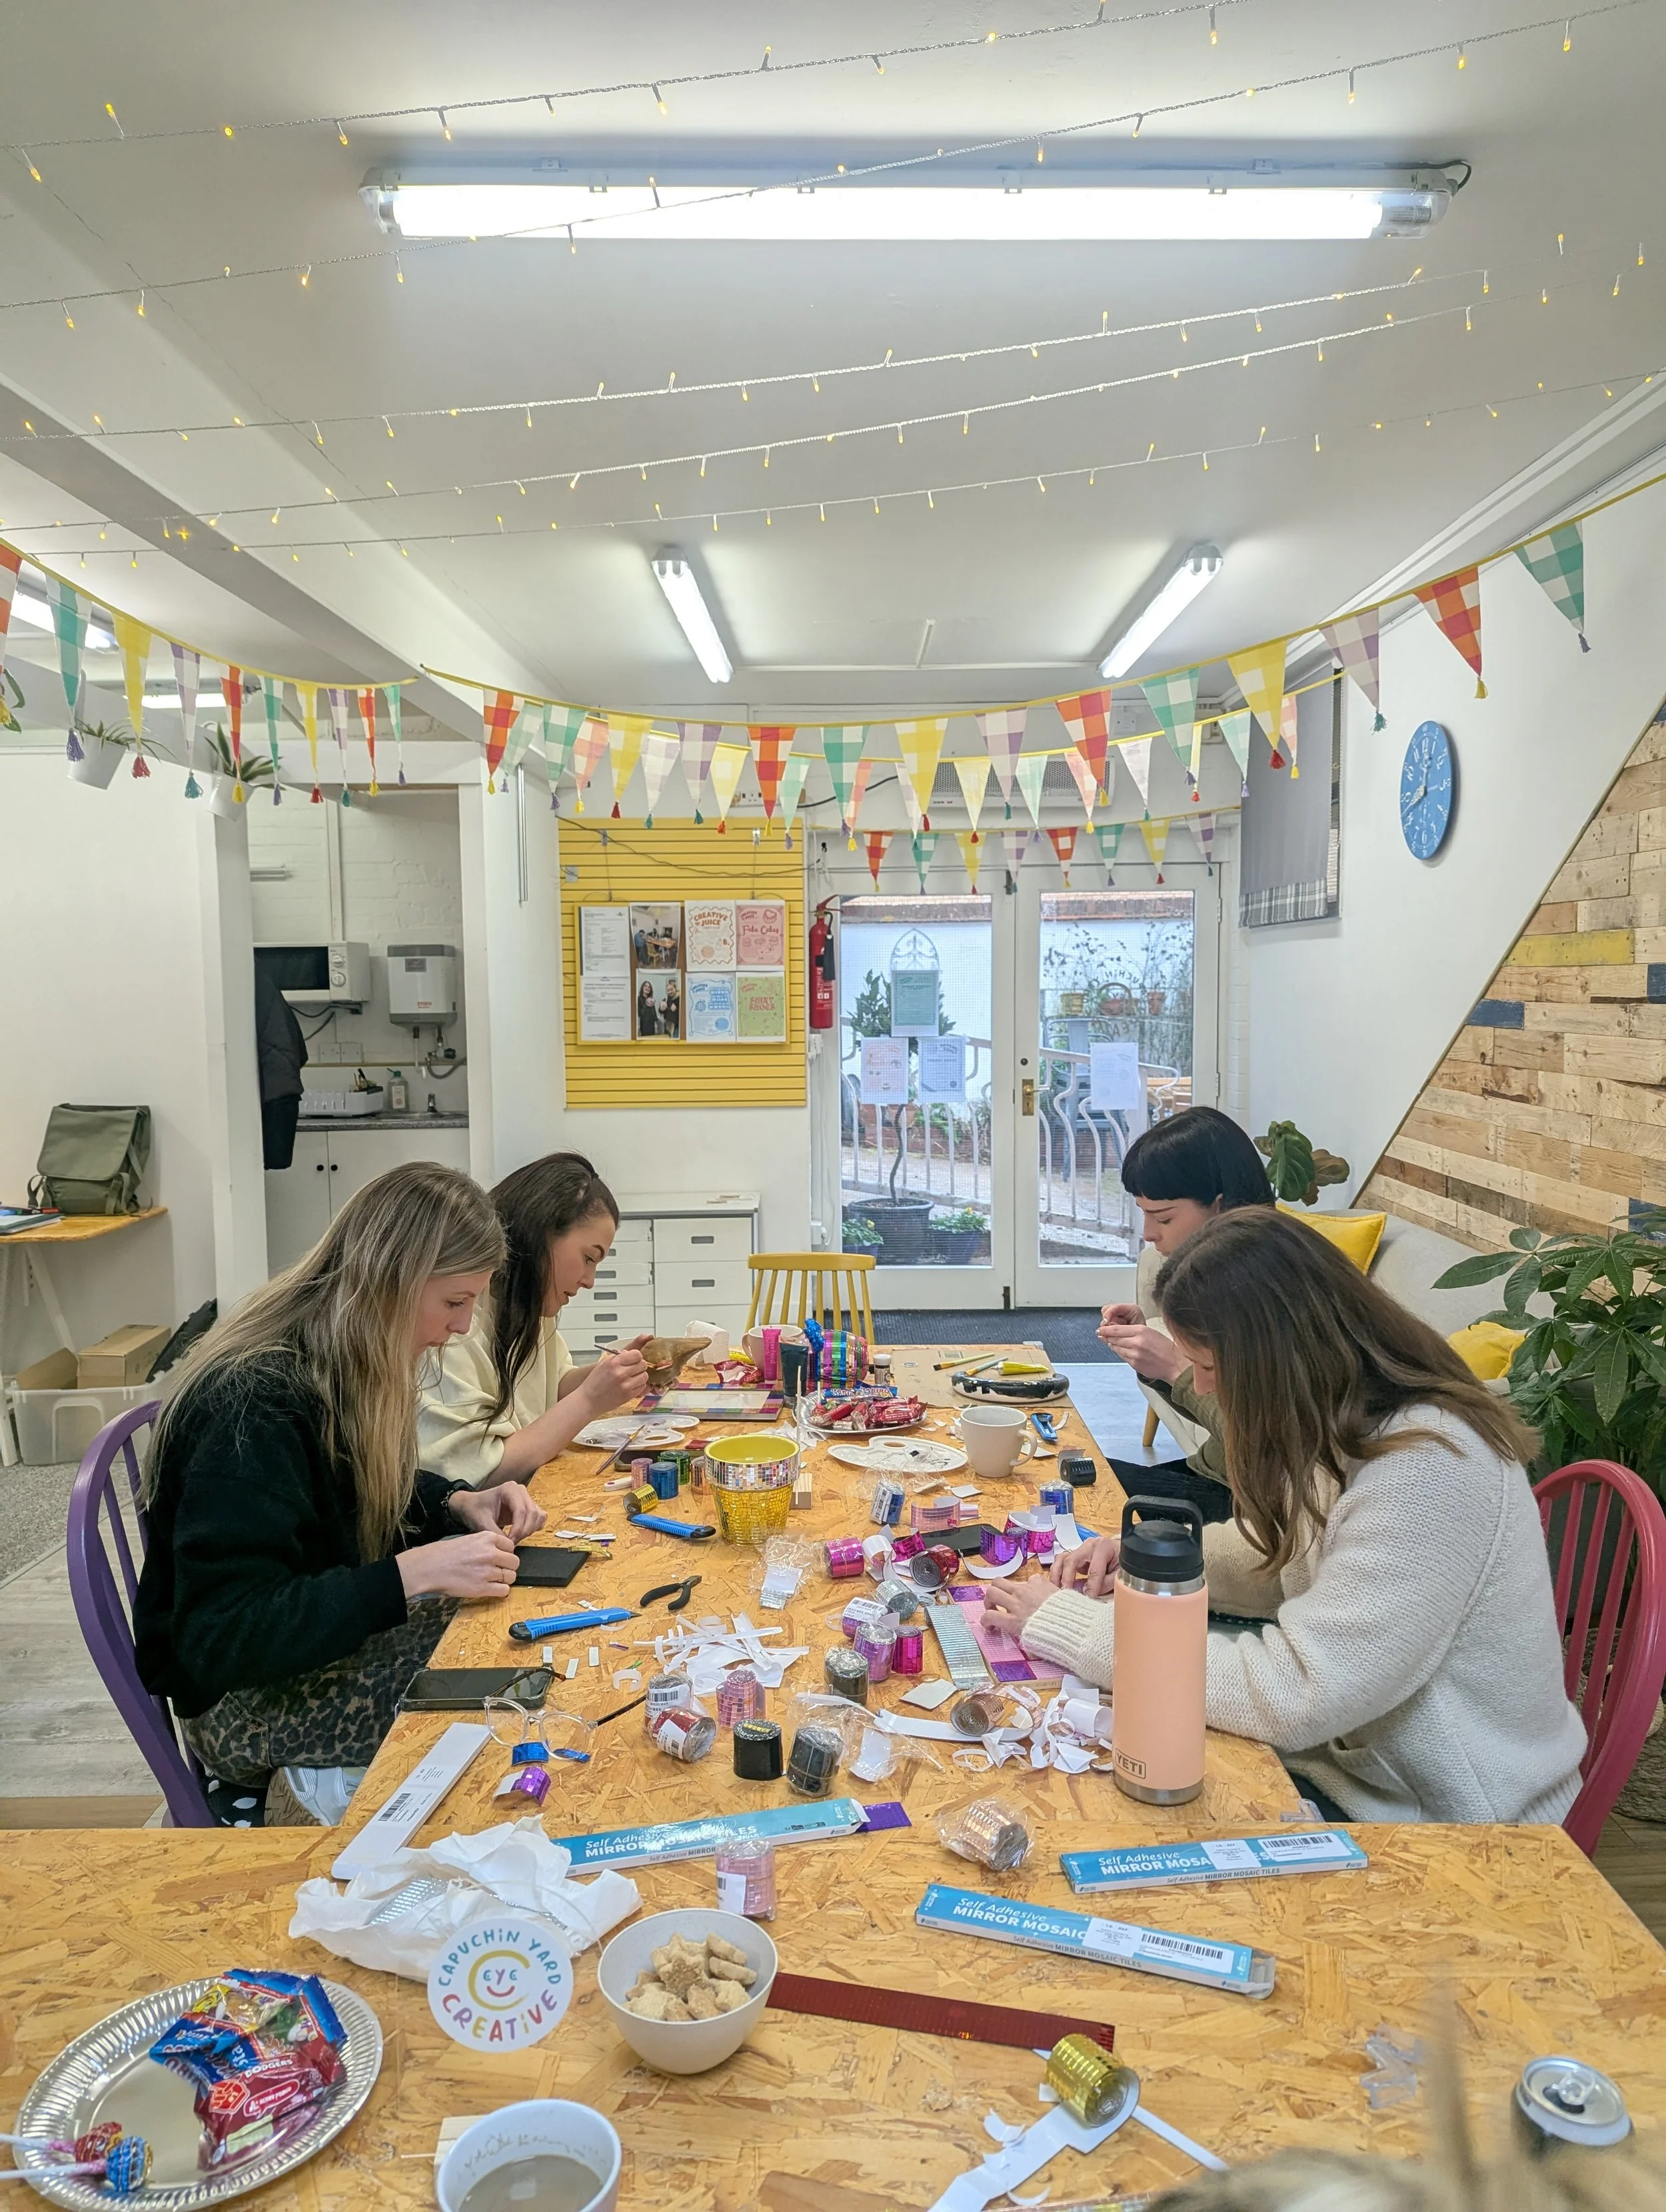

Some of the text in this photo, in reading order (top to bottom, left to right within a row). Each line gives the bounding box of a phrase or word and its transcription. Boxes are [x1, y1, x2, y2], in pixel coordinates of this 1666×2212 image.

[694, 911, 728, 921] CREATIVE
[1117, 1752, 1142, 1775] YETI
[586, 1840, 610, 1850] Self
[661, 1852, 687, 1861] Adhesive
[688, 1847, 716, 1856] MIRROR
[1098, 1852, 1180, 1866] Self Adhesive
[1100, 1857, 1212, 1876] MIRROR MOSA
[1204, 1872, 1232, 1880] MIRROR
[953, 1905, 1019, 1927] MIRROR
[958, 1898, 1047, 1922] Self Adhesive
[528, 1937, 562, 1985] YARD
[1026, 1938, 1054, 1949] Adhesive
[1055, 1943, 1086, 1957] MIRROR
[1087, 1951, 1118, 1963] MOSAIC
[1120, 1959, 1142, 1968] TILES
[245, 2059, 293, 2078] DODGERS
